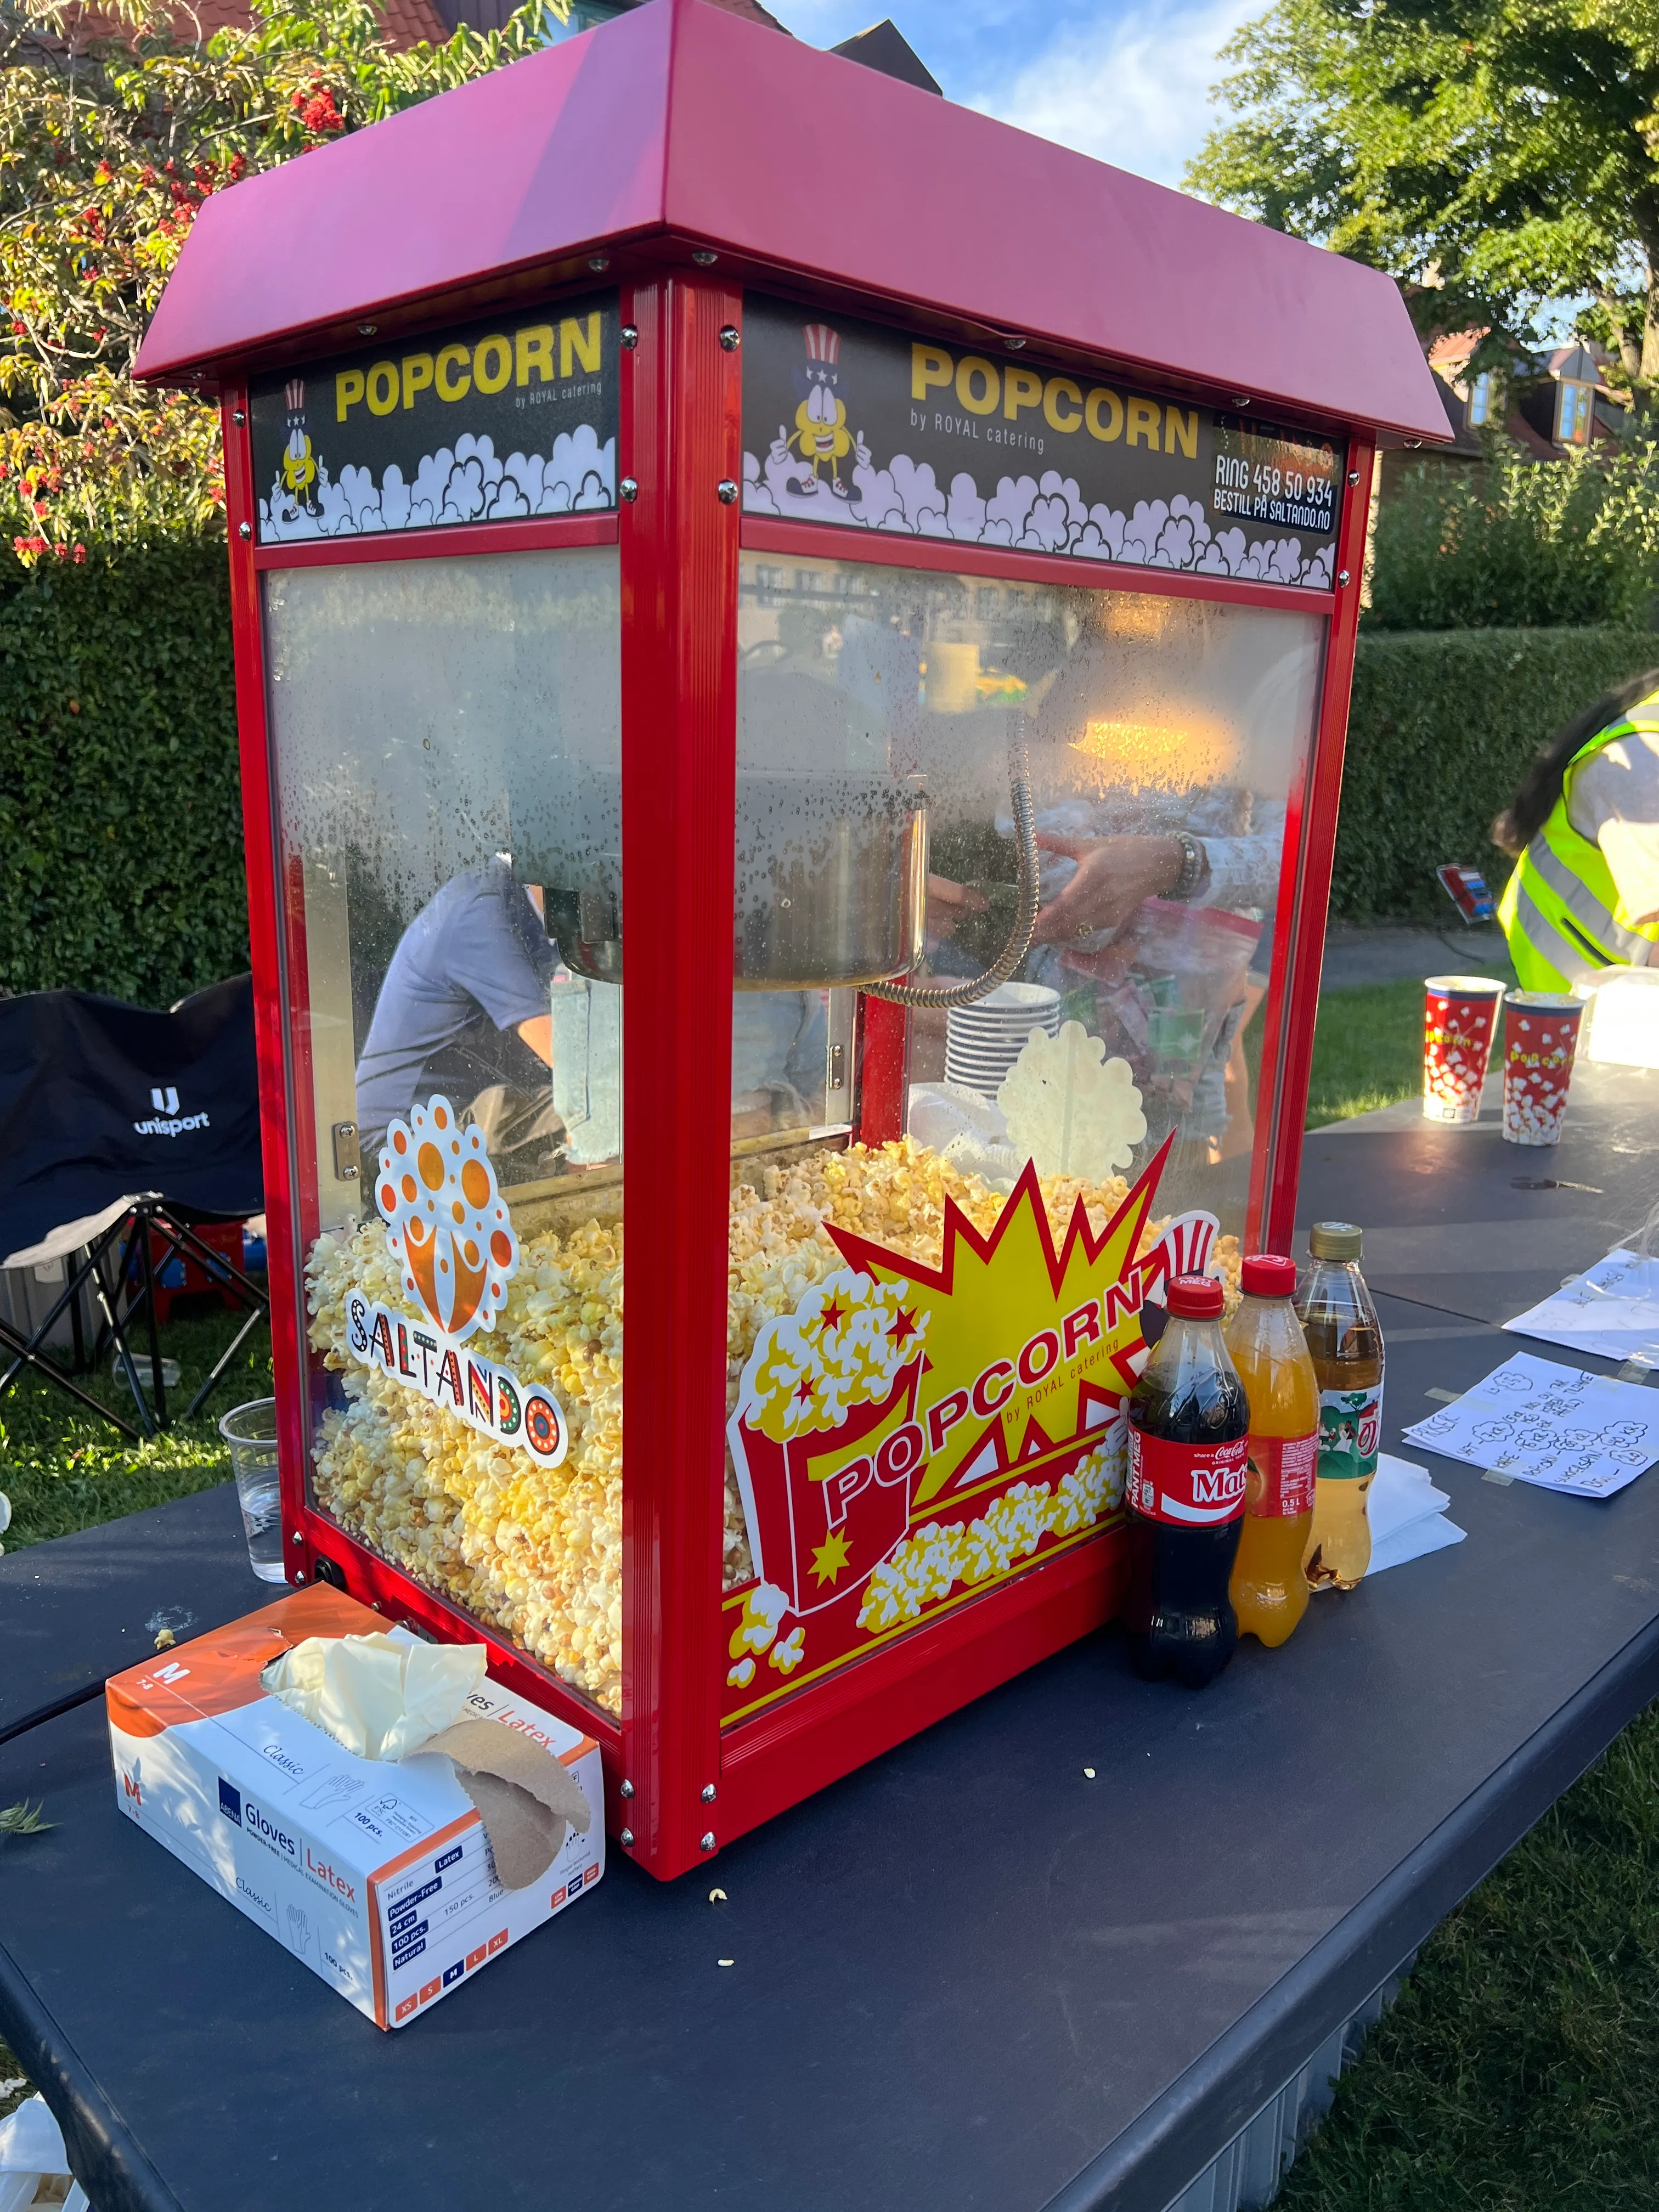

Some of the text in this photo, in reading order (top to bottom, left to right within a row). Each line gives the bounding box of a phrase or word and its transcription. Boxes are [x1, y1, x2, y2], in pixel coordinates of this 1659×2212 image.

[335, 311, 601, 422] POPCORN
[516, 382, 601, 410] by ROYAL catering
[911, 343, 1198, 459] POPCORN
[911, 408, 1043, 455] by ROYAL catering
[1215, 455, 1332, 507] RING 458 50 934
[1214, 488, 1330, 530] BESTILL PÅ SALTANDO.NO
[133, 1111, 210, 1138] unisport
[351, 1299, 560, 1455] SALTANDO
[822, 1266, 1144, 1530] POPCORN
[1007, 1339, 1119, 1423] by ROYAL catering
[1131, 1465, 1140, 1509] PANT
[1282, 1498, 1295, 1508] 0.5
[1296, 1497, 1300, 1505] L
[136, 1679, 154, 1690] 7-8
[153, 1662, 191, 1684] M
[498, 1710, 556, 1747] Latex
[263, 1745, 304, 1775] Classic
[124, 1773, 142, 1807] M
[354, 1812, 371, 1826] 100
[366, 1823, 383, 1837] pcs.
[245, 1803, 356, 1903] Gloves Latex
[246, 1827, 359, 1918] POWDER-FREE MEDICAL EXAMINATION GLOVES
[236, 1877, 272, 1912] Classic
[388, 1850, 459, 1900] Nitrile Latex
[390, 1882, 438, 1918] Powder-Free
[392, 1921, 402, 1934] 24
[404, 1914, 415, 1927] cm
[394, 1935, 409, 1950] 100
[411, 1926, 426, 1942] pcs.
[444, 1902, 459, 1916] 150
[460, 1894, 475, 1908] pcs.
[394, 1889, 504, 1967] Natural Blue
[325, 1952, 353, 1980] 100 pcs.
[402, 2001, 411, 2014] XS
[428, 1986, 433, 1995] S
[450, 1968, 458, 1979] M
[493, 1937, 503, 1948] XL
